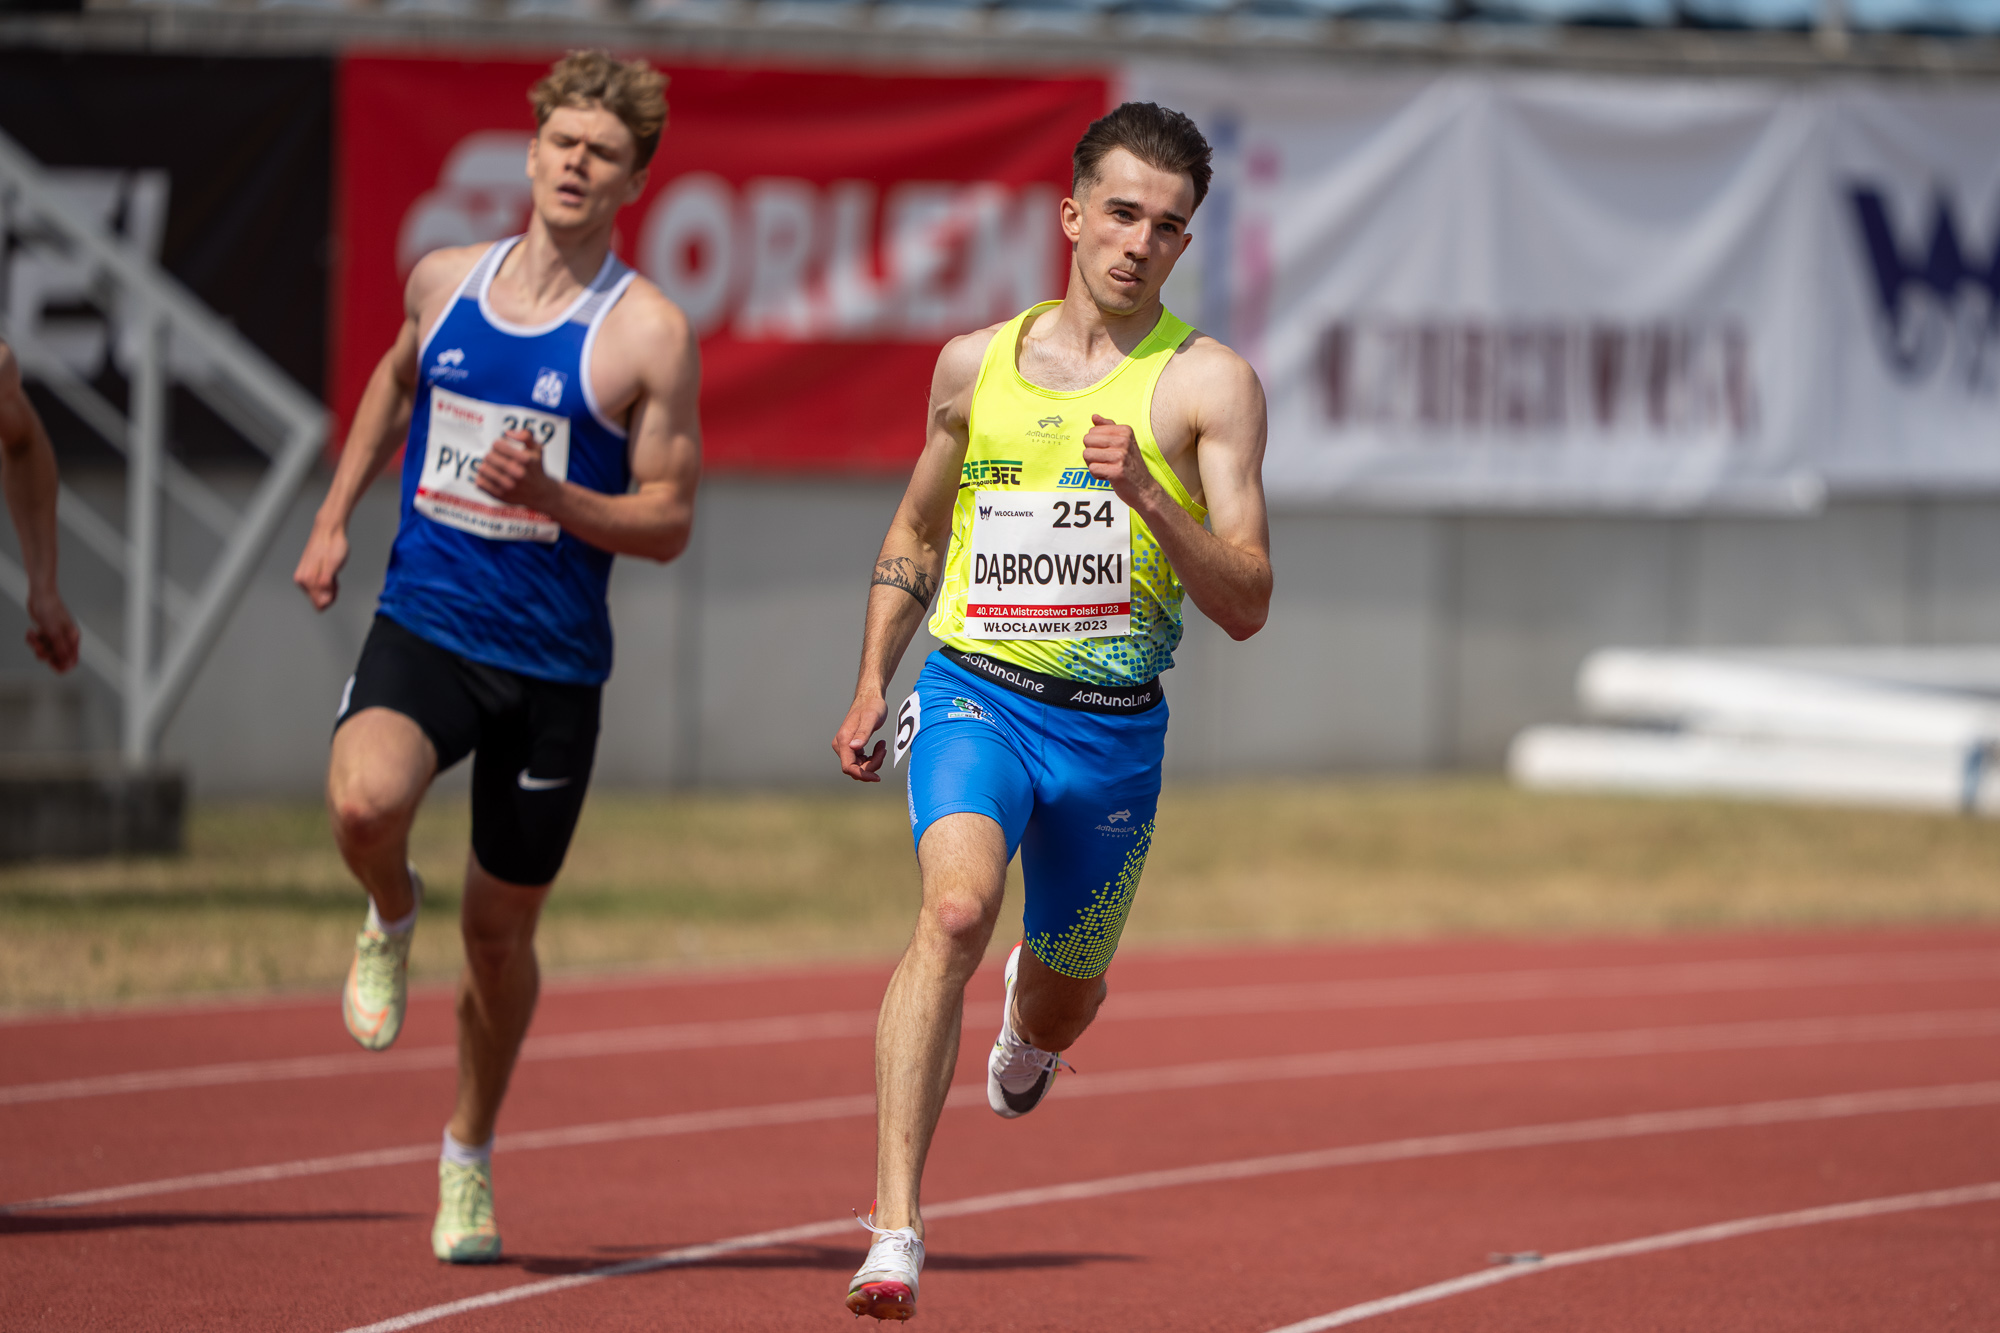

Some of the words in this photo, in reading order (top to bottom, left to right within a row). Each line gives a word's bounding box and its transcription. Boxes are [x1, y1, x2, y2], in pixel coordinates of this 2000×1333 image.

[436, 445, 484, 483] PYS
[1052, 500, 1115, 529] 254
[974, 553, 1123, 592] DĄBROWSKI
[976, 606, 988, 616] 40.
[989, 606, 1009, 616] PZLA
[1010, 606, 1068, 616] Mistrzostwa
[1070, 606, 1099, 616] Polski
[1101, 605, 1120, 614] U23
[983, 621, 1071, 633] WŁOCŁAWEK
[1074, 619, 1108, 631] 2023
[960, 651, 1045, 693] AdRunaLine
[1070, 690, 1151, 707] AdRunaLine
[897, 699, 915, 751] 5
